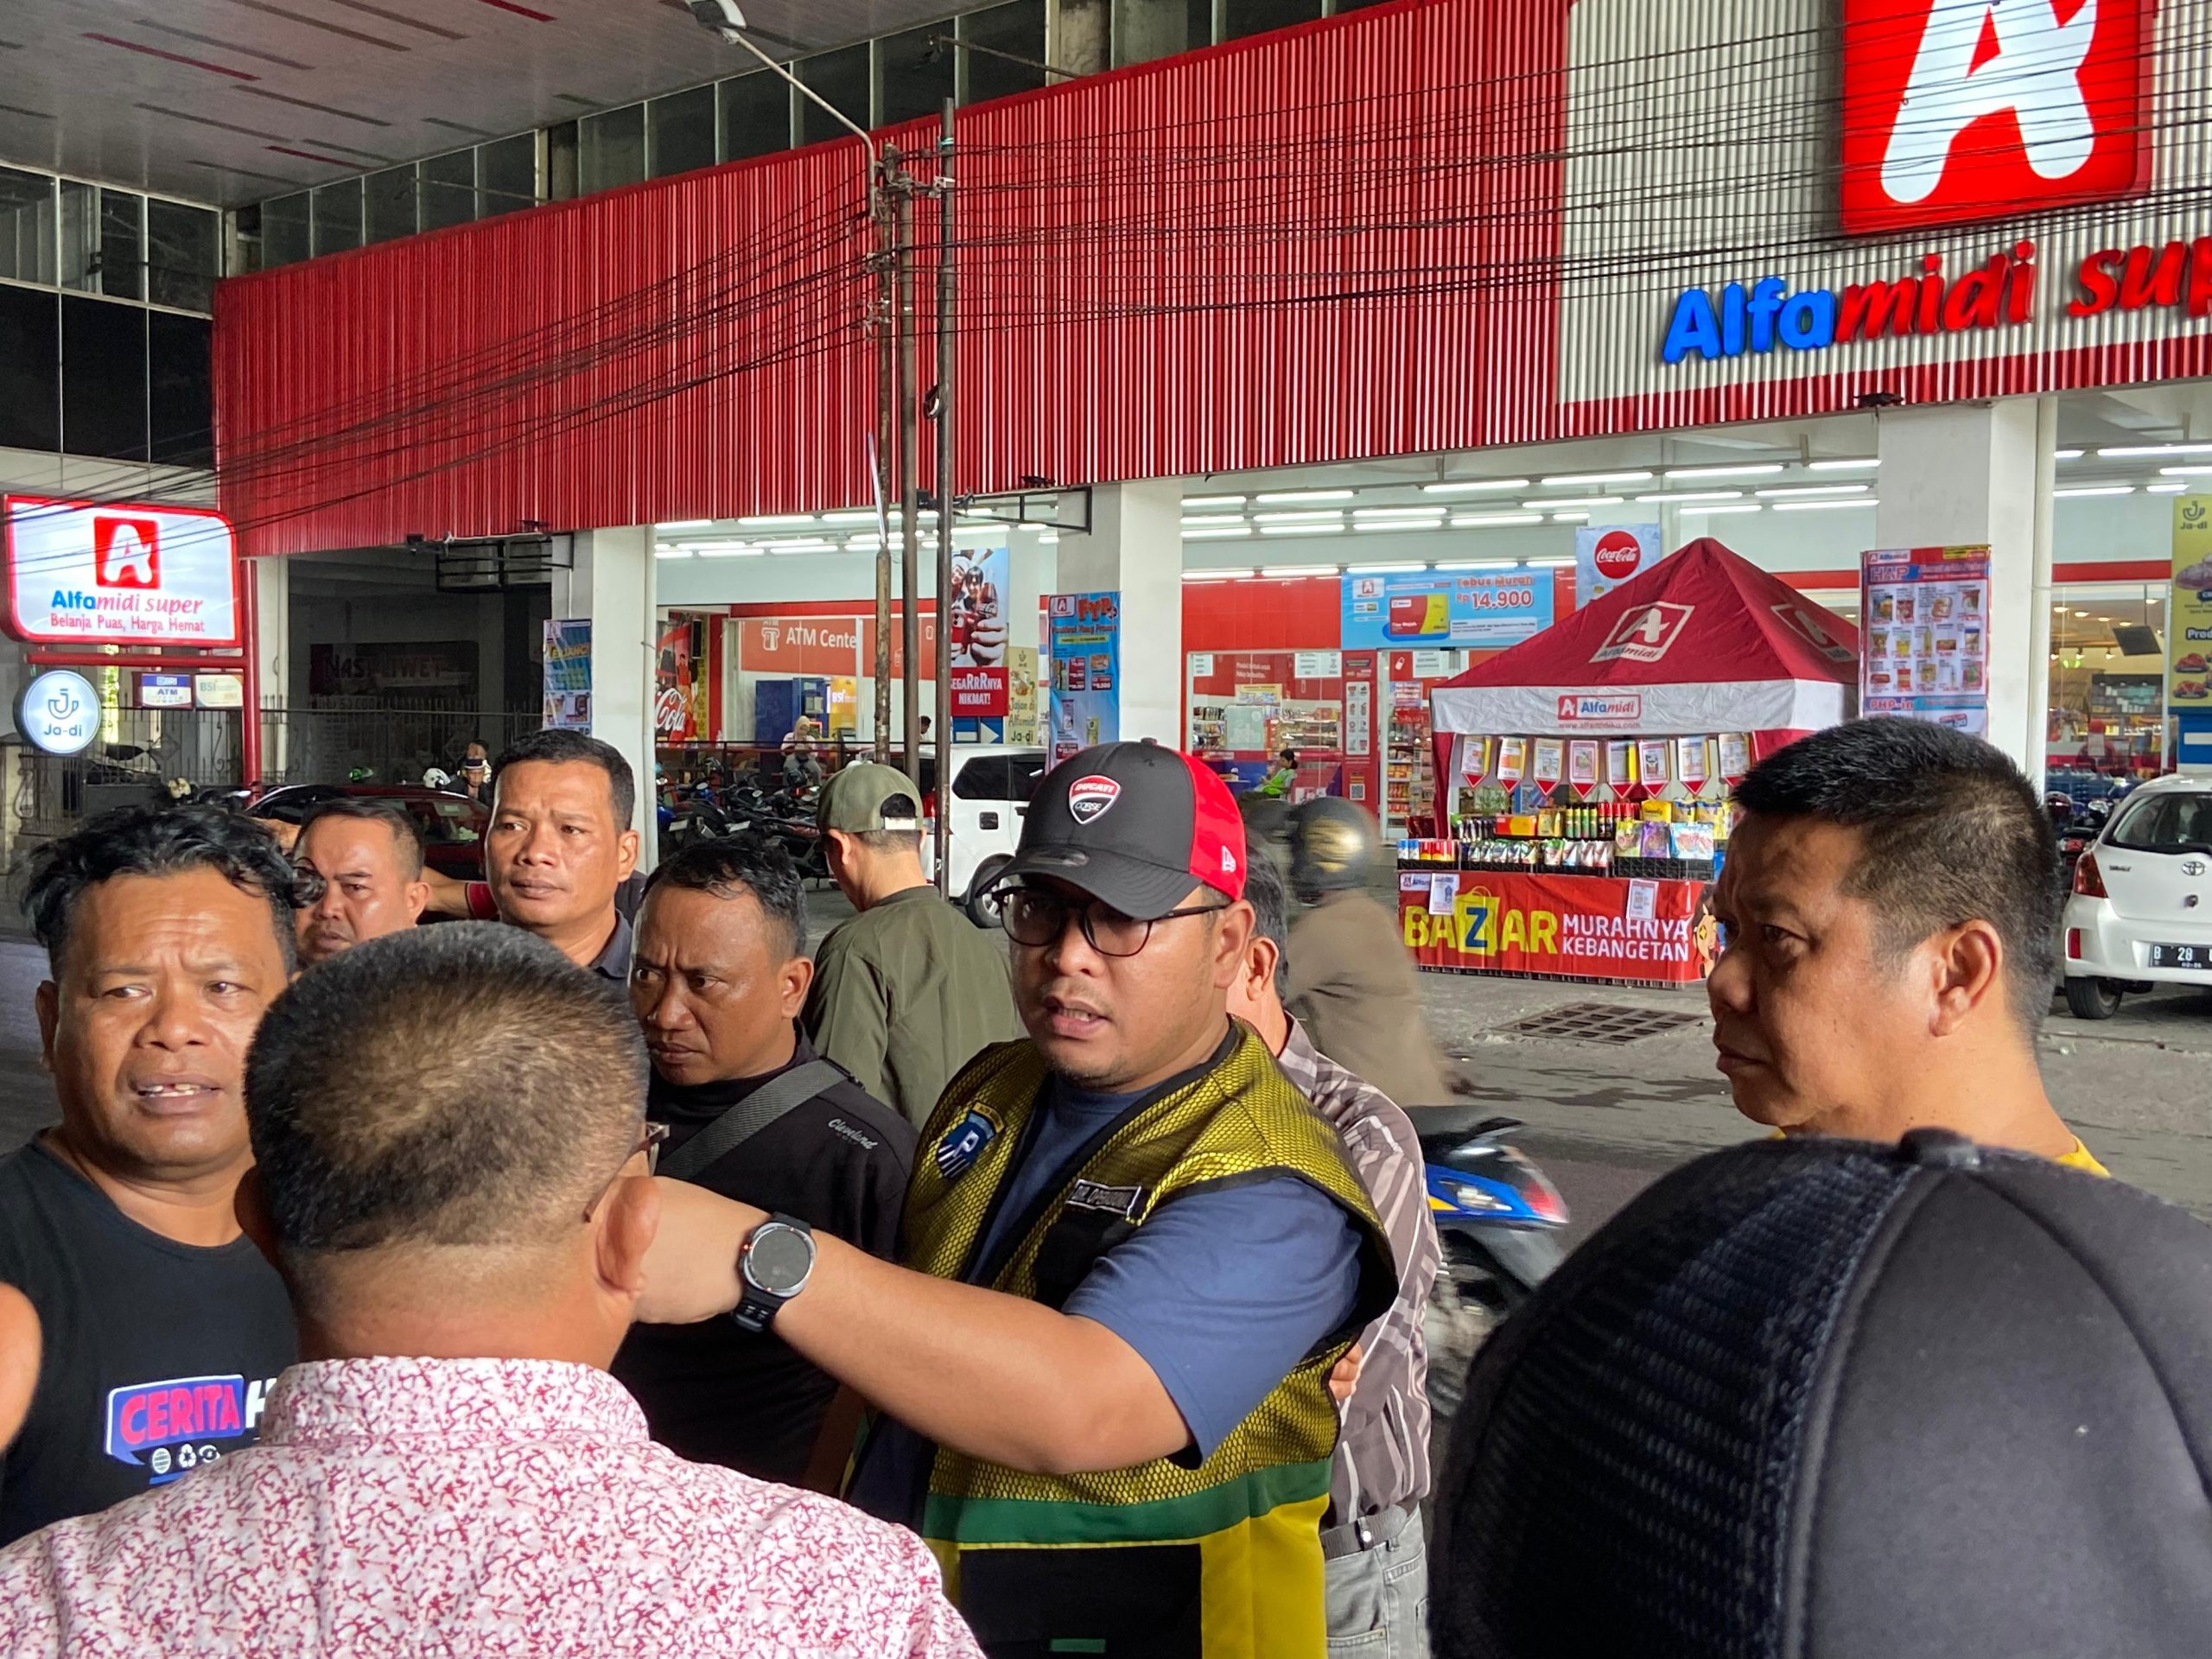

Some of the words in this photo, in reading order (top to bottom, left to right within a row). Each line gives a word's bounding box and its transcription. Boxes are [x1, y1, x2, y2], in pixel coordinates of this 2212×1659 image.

[1662, 240, 2036, 364] Alfamidi
[1596, 546, 1639, 563] Coca-Cola
[1456, 577, 1492, 588] Tebus
[1494, 575, 1535, 588] Murah
[51, 590, 140, 612] Alfamidi
[144, 597, 204, 616] super
[1456, 593, 1470, 603] Rp
[1471, 589, 1534, 609] 14.900
[50, 613, 92, 632] Belanja
[97, 614, 126, 631] Puas,
[130, 615, 163, 634] Harga
[168, 617, 205, 632] Hemat
[785, 626, 817, 646] ATM
[819, 629, 856, 648] Cente
[1597, 646, 1659, 658] Alfamidi
[958, 692, 991, 705] NIKMAT!
[1580, 701, 1635, 714] Alfamidi
[43, 724, 83, 737] Ja-di
[1011, 730, 1033, 741] Ja-di
[1074, 782, 1116, 794] DUCATI
[1404, 905, 1560, 956] BAZAR
[1562, 912, 1689, 942] MURAHNYA
[1562, 936, 1689, 962] KEBANGETAN
[2153, 945, 2162, 960] B
[2177, 947, 2193, 961] 28
[119, 1384, 241, 1445] CERITA
